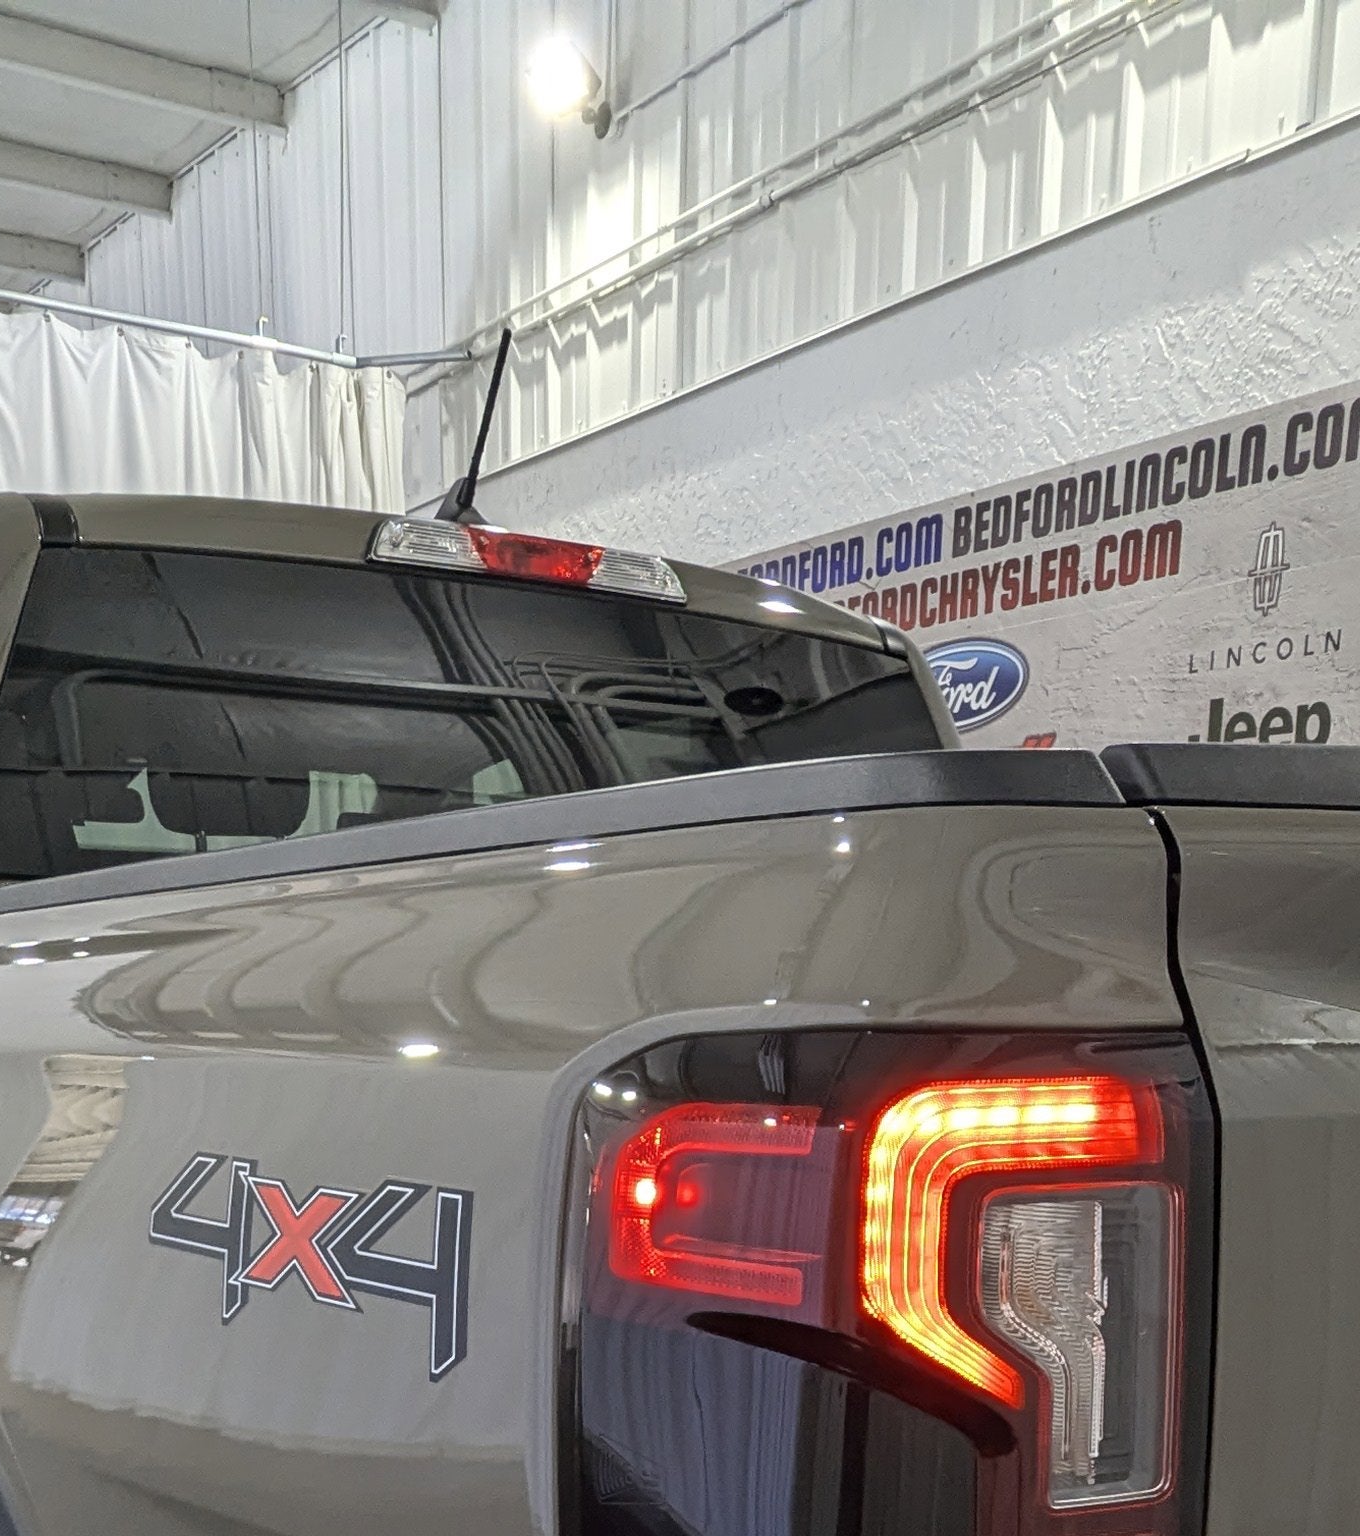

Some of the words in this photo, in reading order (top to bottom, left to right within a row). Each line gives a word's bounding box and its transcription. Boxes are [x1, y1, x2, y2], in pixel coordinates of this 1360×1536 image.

[738, 513, 943, 594] DFORD.COM
[833, 519, 1182, 631] RDCHRYSLER.COM
[1188, 629, 1342, 674] LINCOLN
[1188, 697, 1332, 743] Jeep
